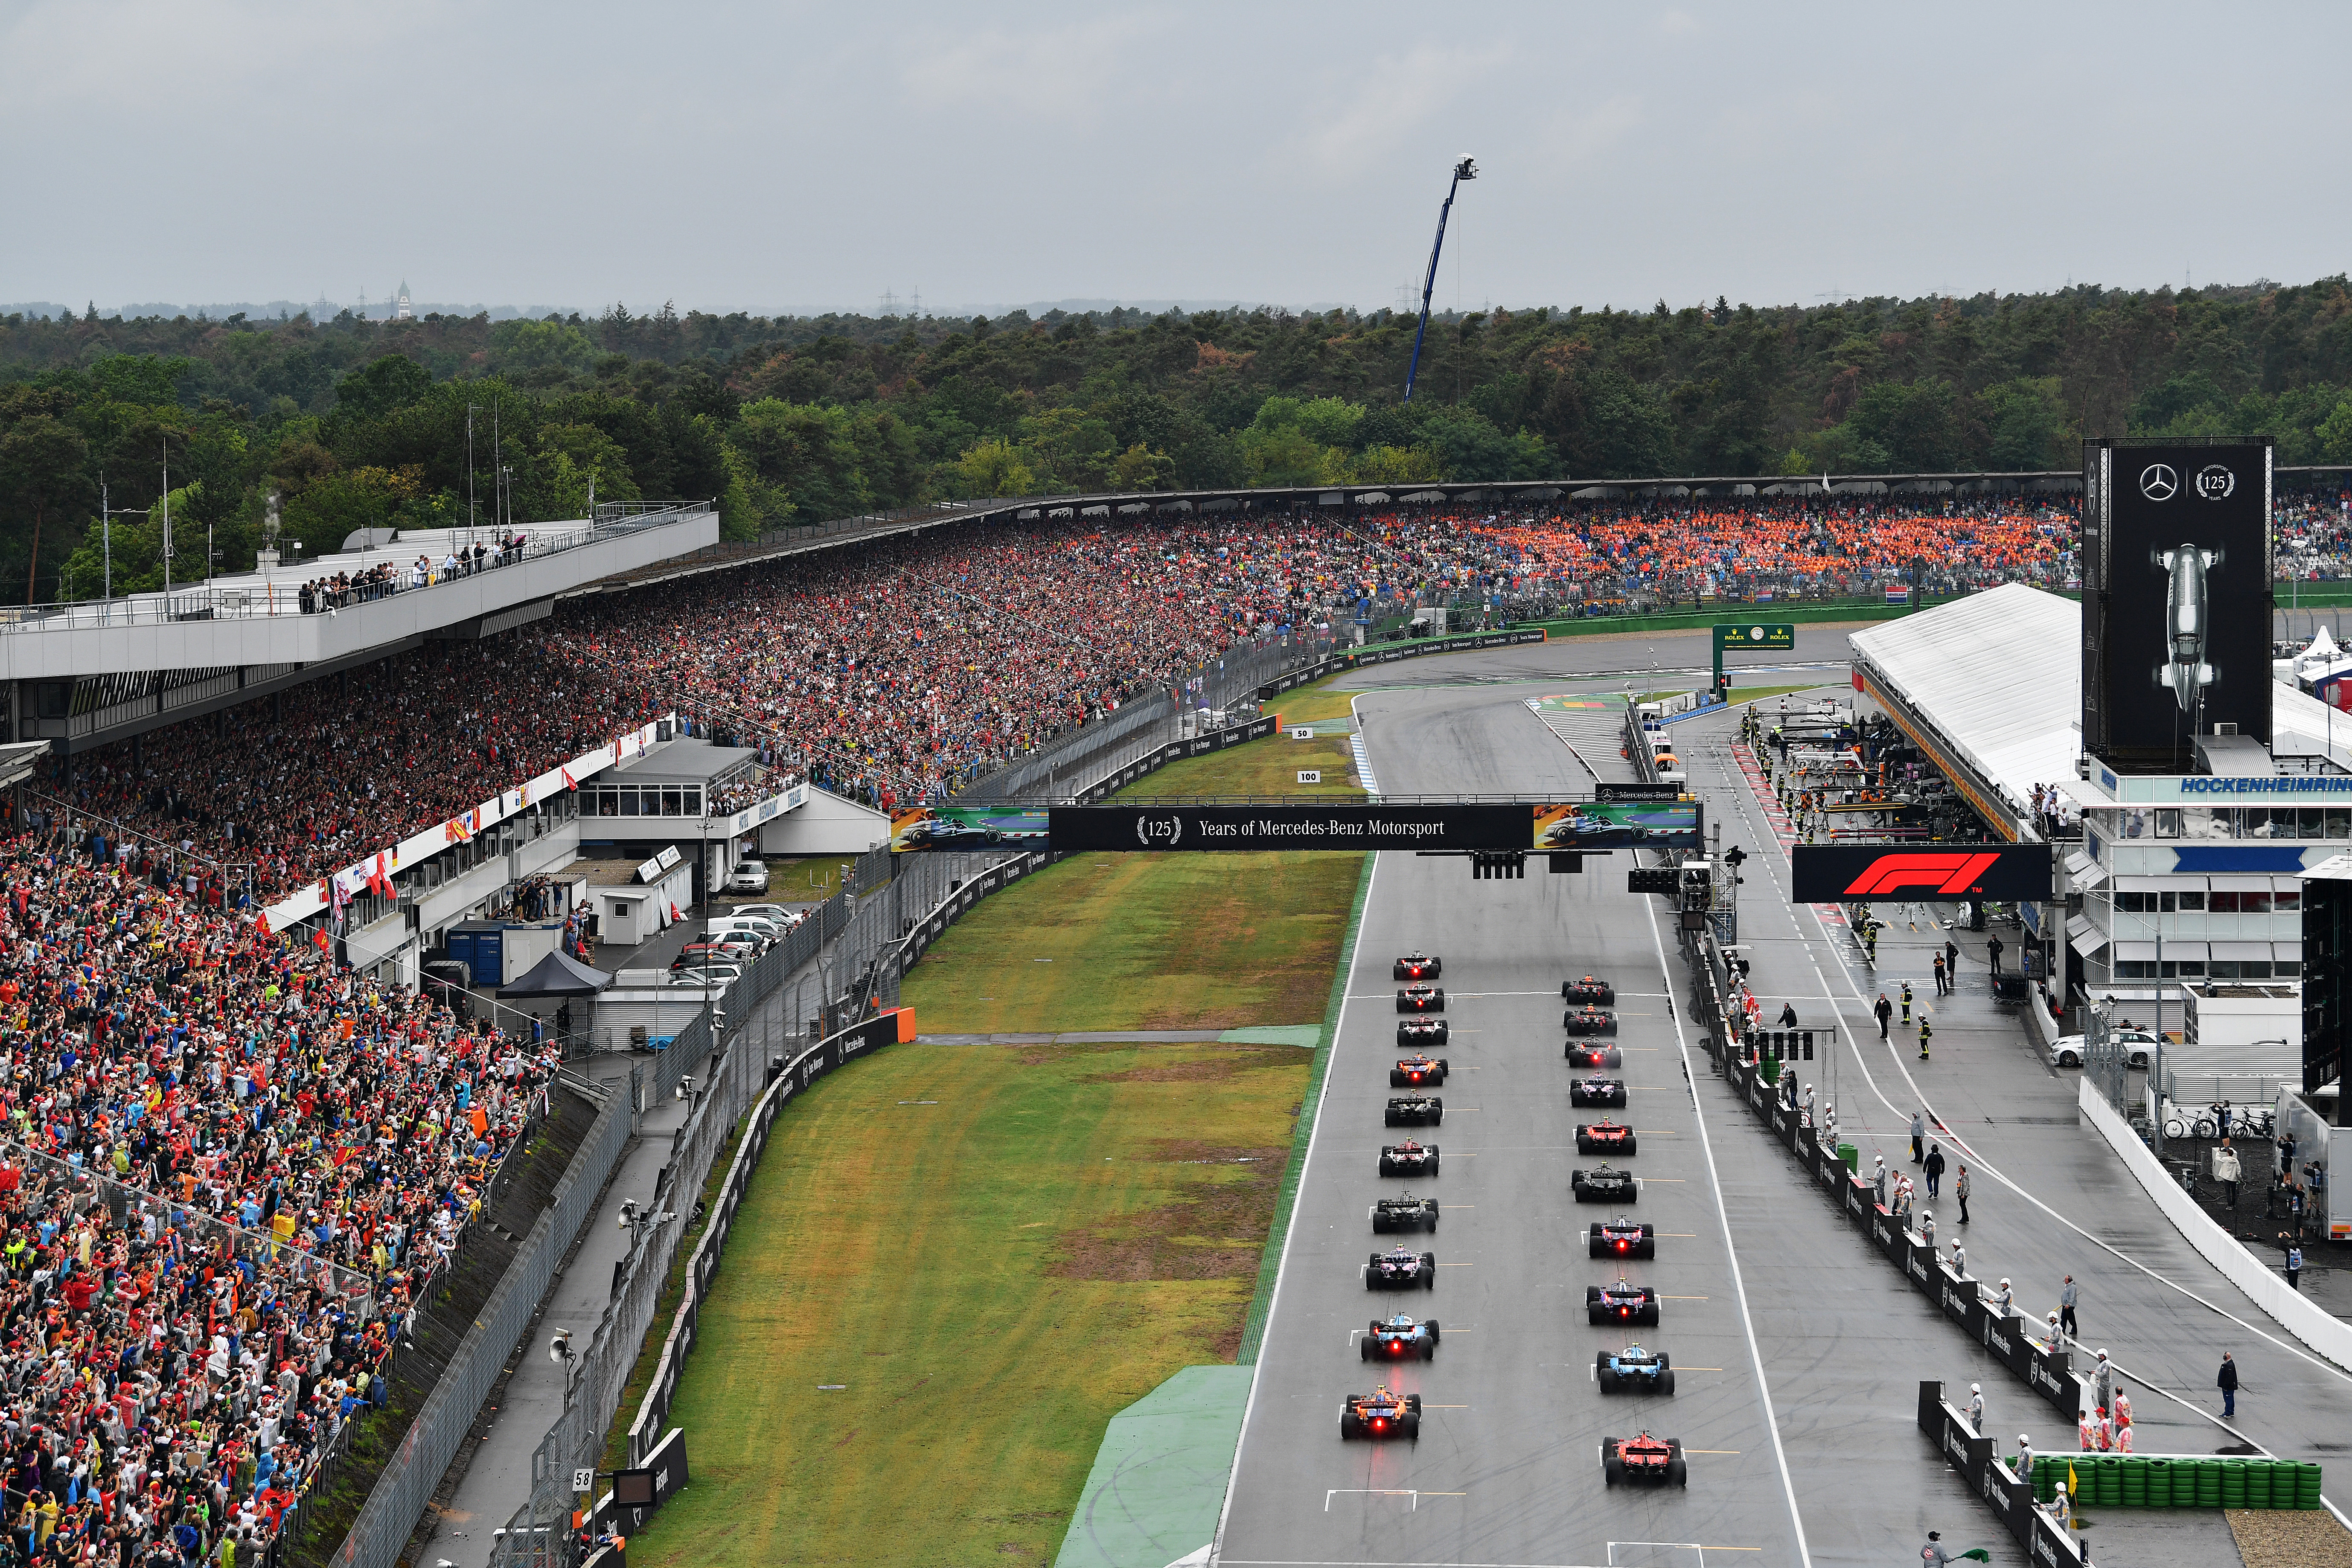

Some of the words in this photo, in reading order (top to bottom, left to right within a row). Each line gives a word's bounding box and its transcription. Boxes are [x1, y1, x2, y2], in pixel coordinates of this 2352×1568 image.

[2202, 464, 2229, 473] MOTORSPORT
[2204, 475, 2225, 489] 125
[739, 812, 749, 831] HOTEL
[759, 799, 778, 822] RESTAURANT
[1149, 821, 1173, 839] 125
[1199, 821, 1236, 835] Years
[1242, 820, 1255, 835] of
[1259, 820, 1362, 835] Mercedes-Benz
[1368, 820, 1444, 838] Motorsport
[576, 1472, 590, 1486] 58
